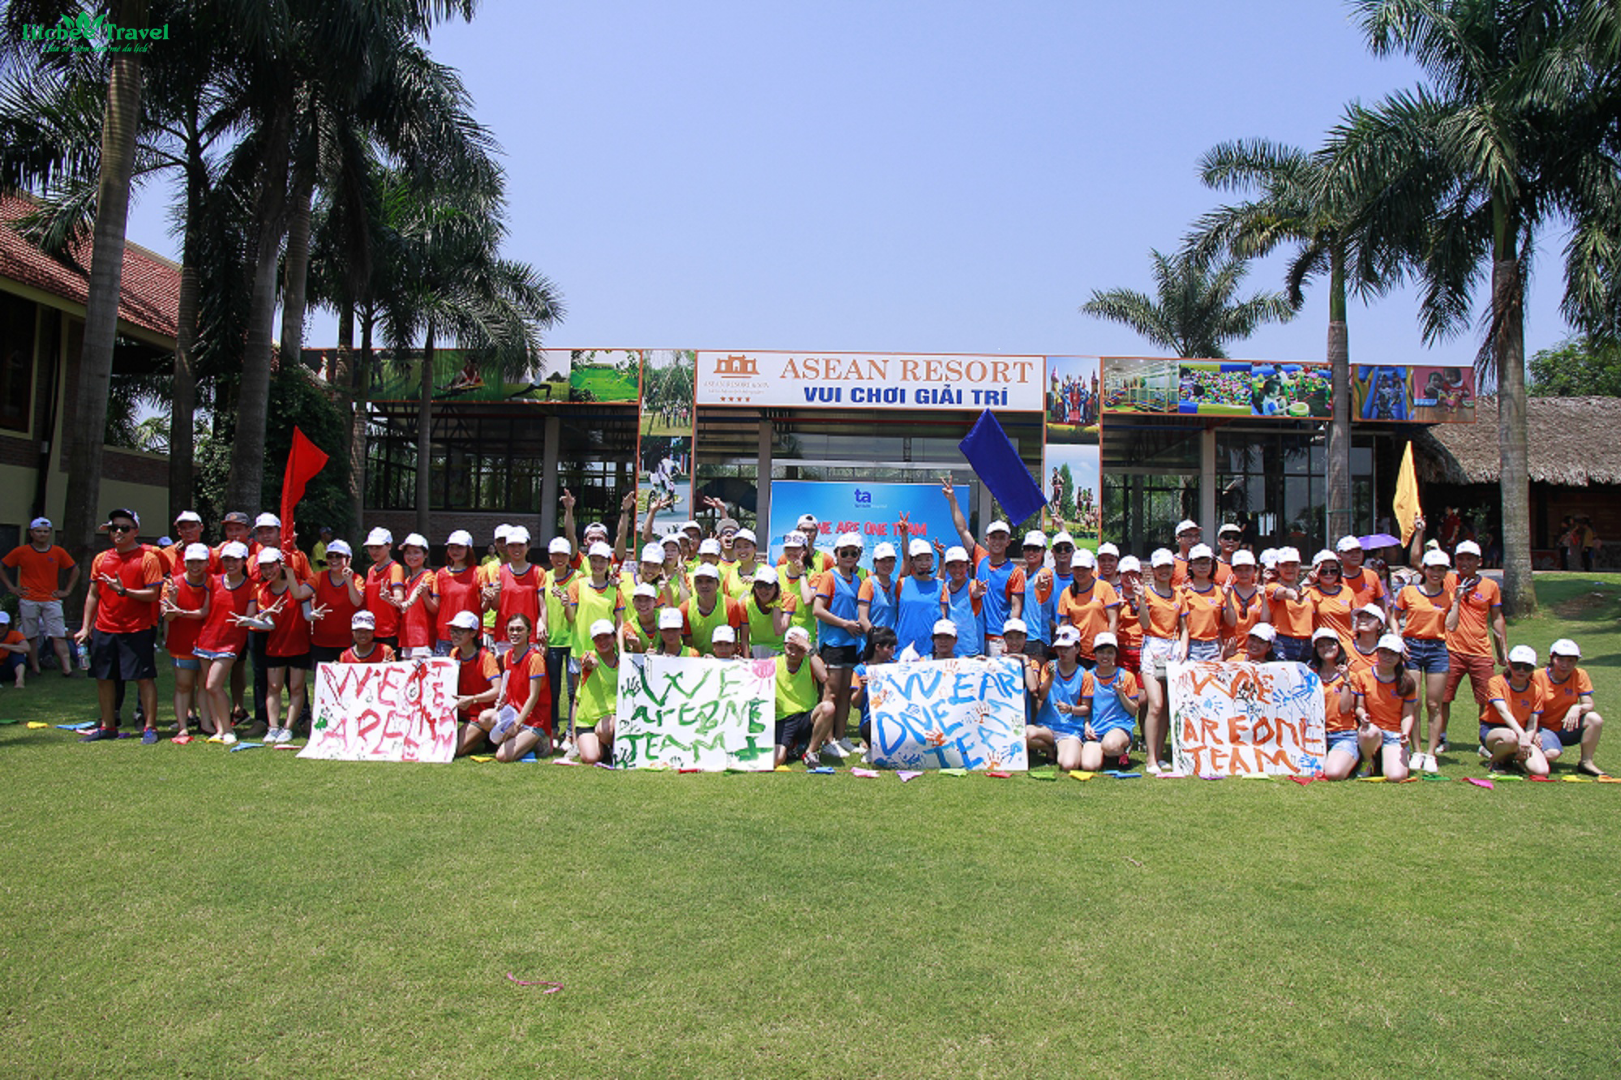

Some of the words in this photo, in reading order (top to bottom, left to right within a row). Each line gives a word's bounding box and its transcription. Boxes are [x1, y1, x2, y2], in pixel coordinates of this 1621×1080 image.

[779, 357, 890, 381] ASEAN
[900, 359, 1034, 384] RESORT
[804, 386, 842, 403] VUI
[850, 386, 906, 404] CHƠI
[914, 384, 963, 404] GIẢI
[971, 387, 1008, 406] TRÍ
[854, 488, 872, 503] ta
[835, 521, 861, 535] ARE
[864, 522, 888, 536] ONE
[629, 658, 742, 707] WE
[617, 731, 727, 764] TEAM
[1181, 745, 1301, 776] TEAM
